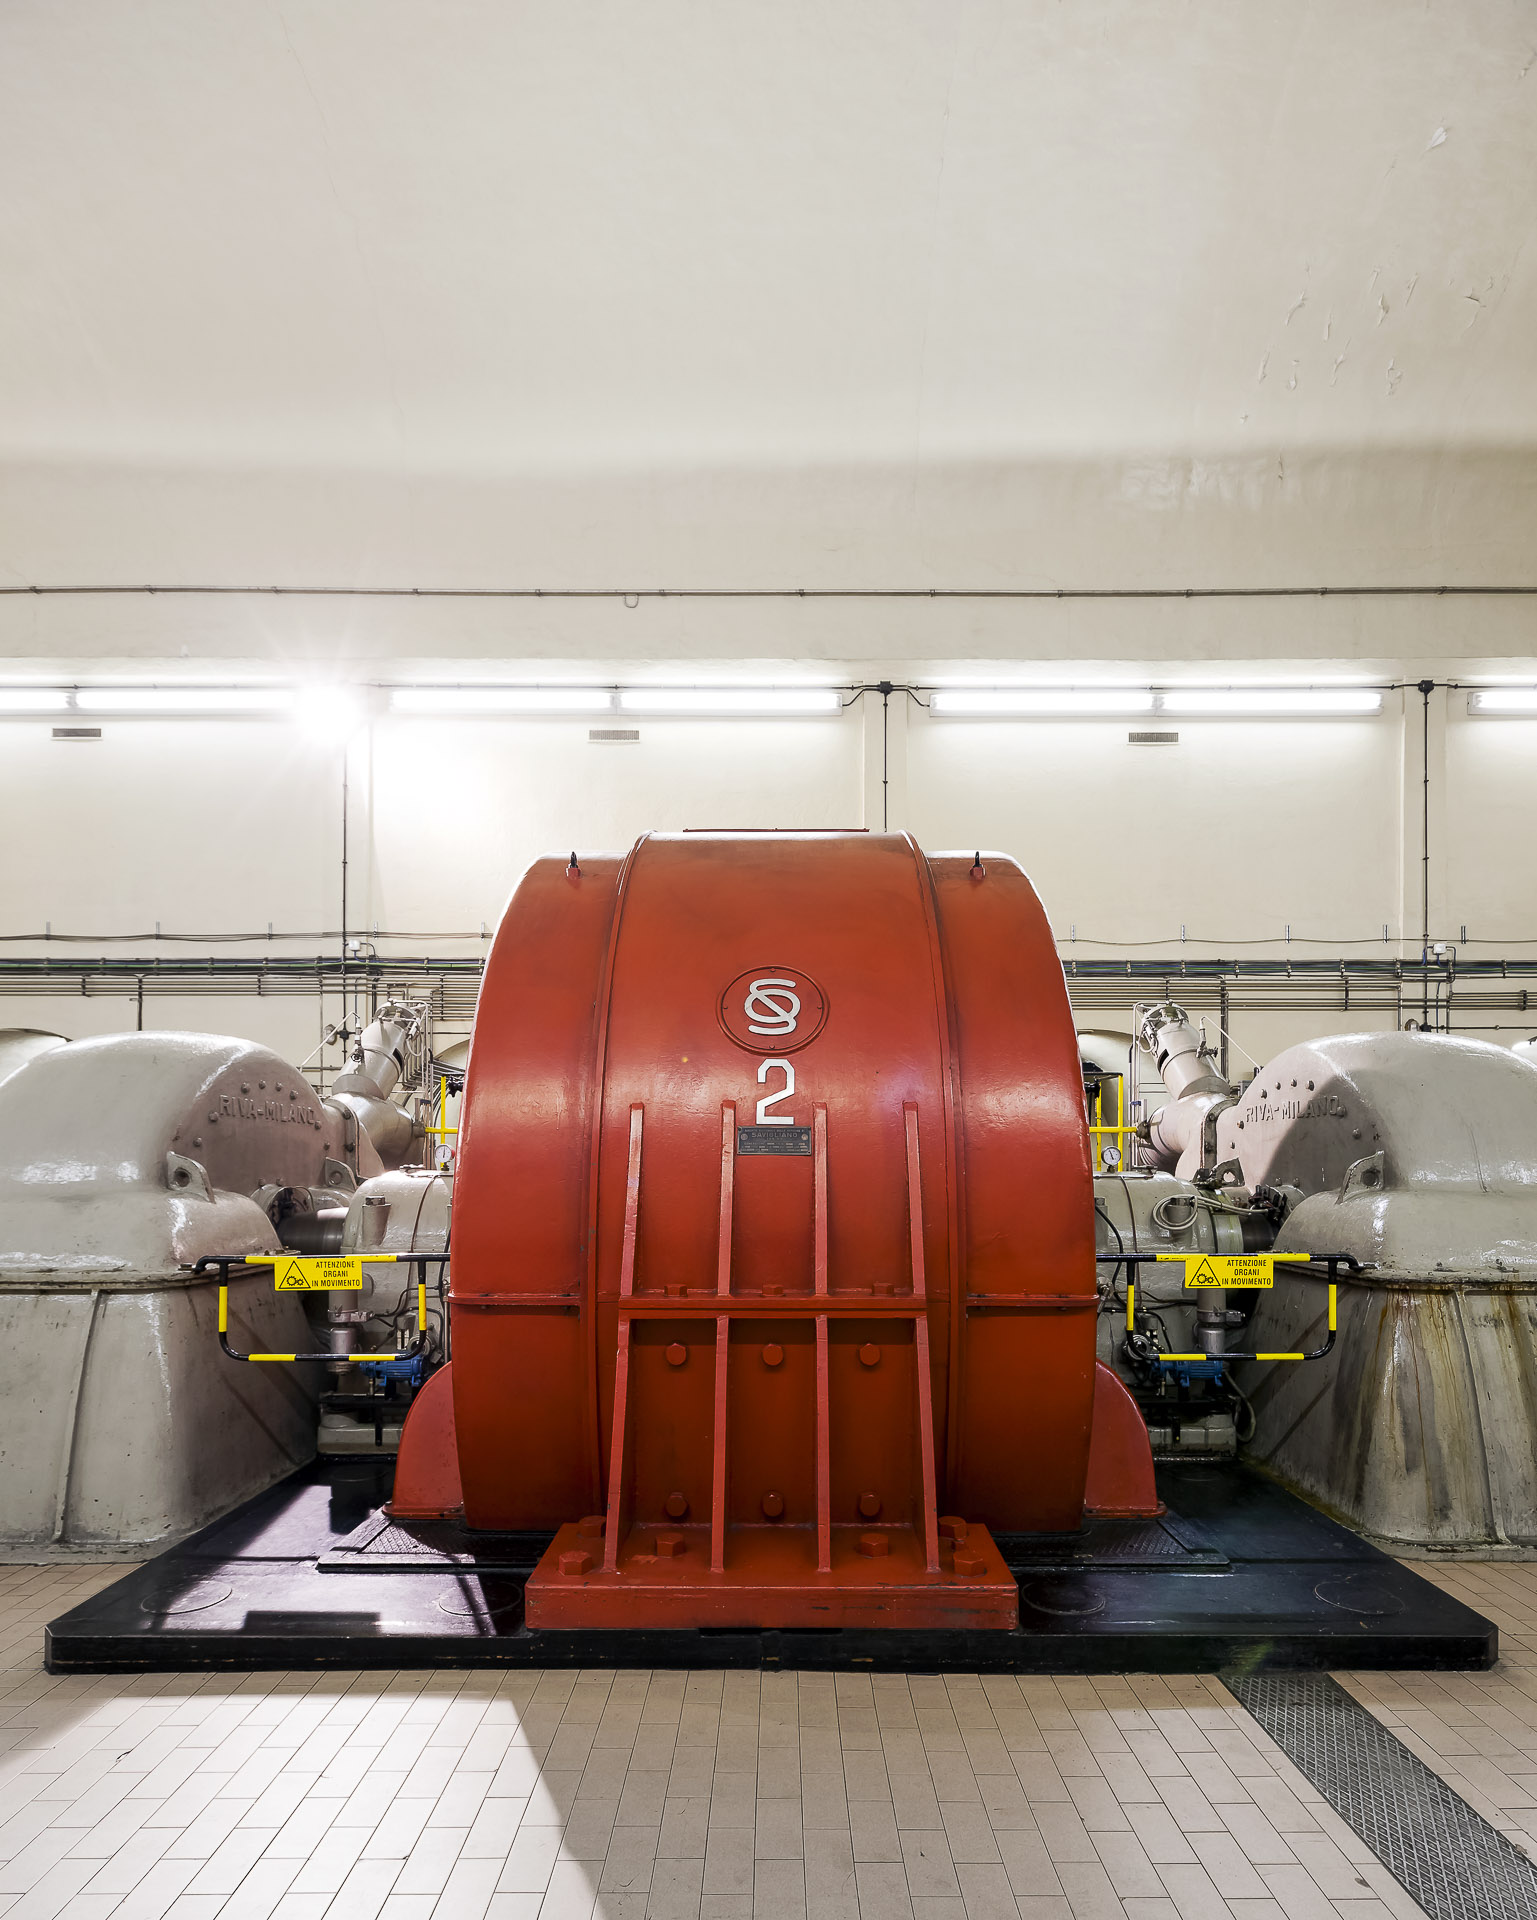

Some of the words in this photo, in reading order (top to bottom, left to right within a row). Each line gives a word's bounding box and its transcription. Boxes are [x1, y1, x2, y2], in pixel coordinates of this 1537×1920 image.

[756, 1058, 795, 1125] 2
[220, 1094, 315, 1125] RIVA-MILANO
[1246, 1095, 1340, 1122] RIVA-MILANO
[1226, 1259, 1267, 1267] ATTENZIONE
[323, 1270, 349, 1278] ORGANI
[1234, 1268, 1260, 1276] ORGANI
[320, 1279, 361, 1287] MOVIMENTO
[1230, 1277, 1272, 1285] MOVIMENTO
